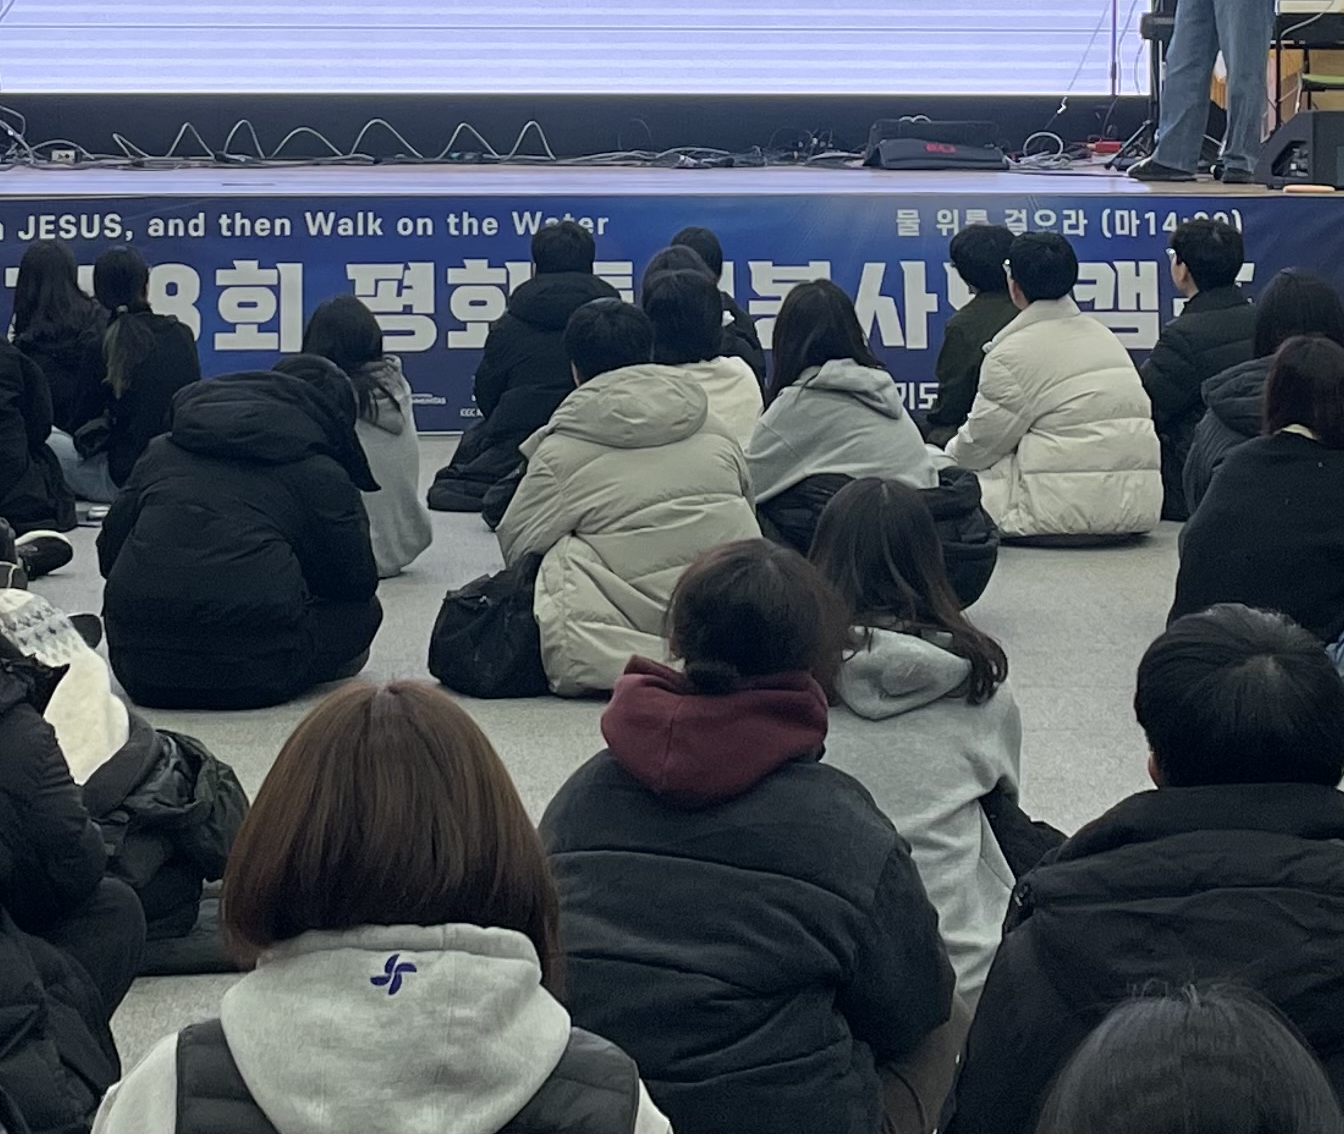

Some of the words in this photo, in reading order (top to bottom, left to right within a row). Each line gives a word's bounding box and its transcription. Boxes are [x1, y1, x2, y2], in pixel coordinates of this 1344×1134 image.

[17, 214, 134, 241] JESUS,
[148, 213, 205, 237] and
[219, 212, 292, 237] then
[305, 212, 383, 236] Walk
[396, 216, 434, 236] on
[447, 213, 498, 235] the
[896, 209, 920, 236] 물
